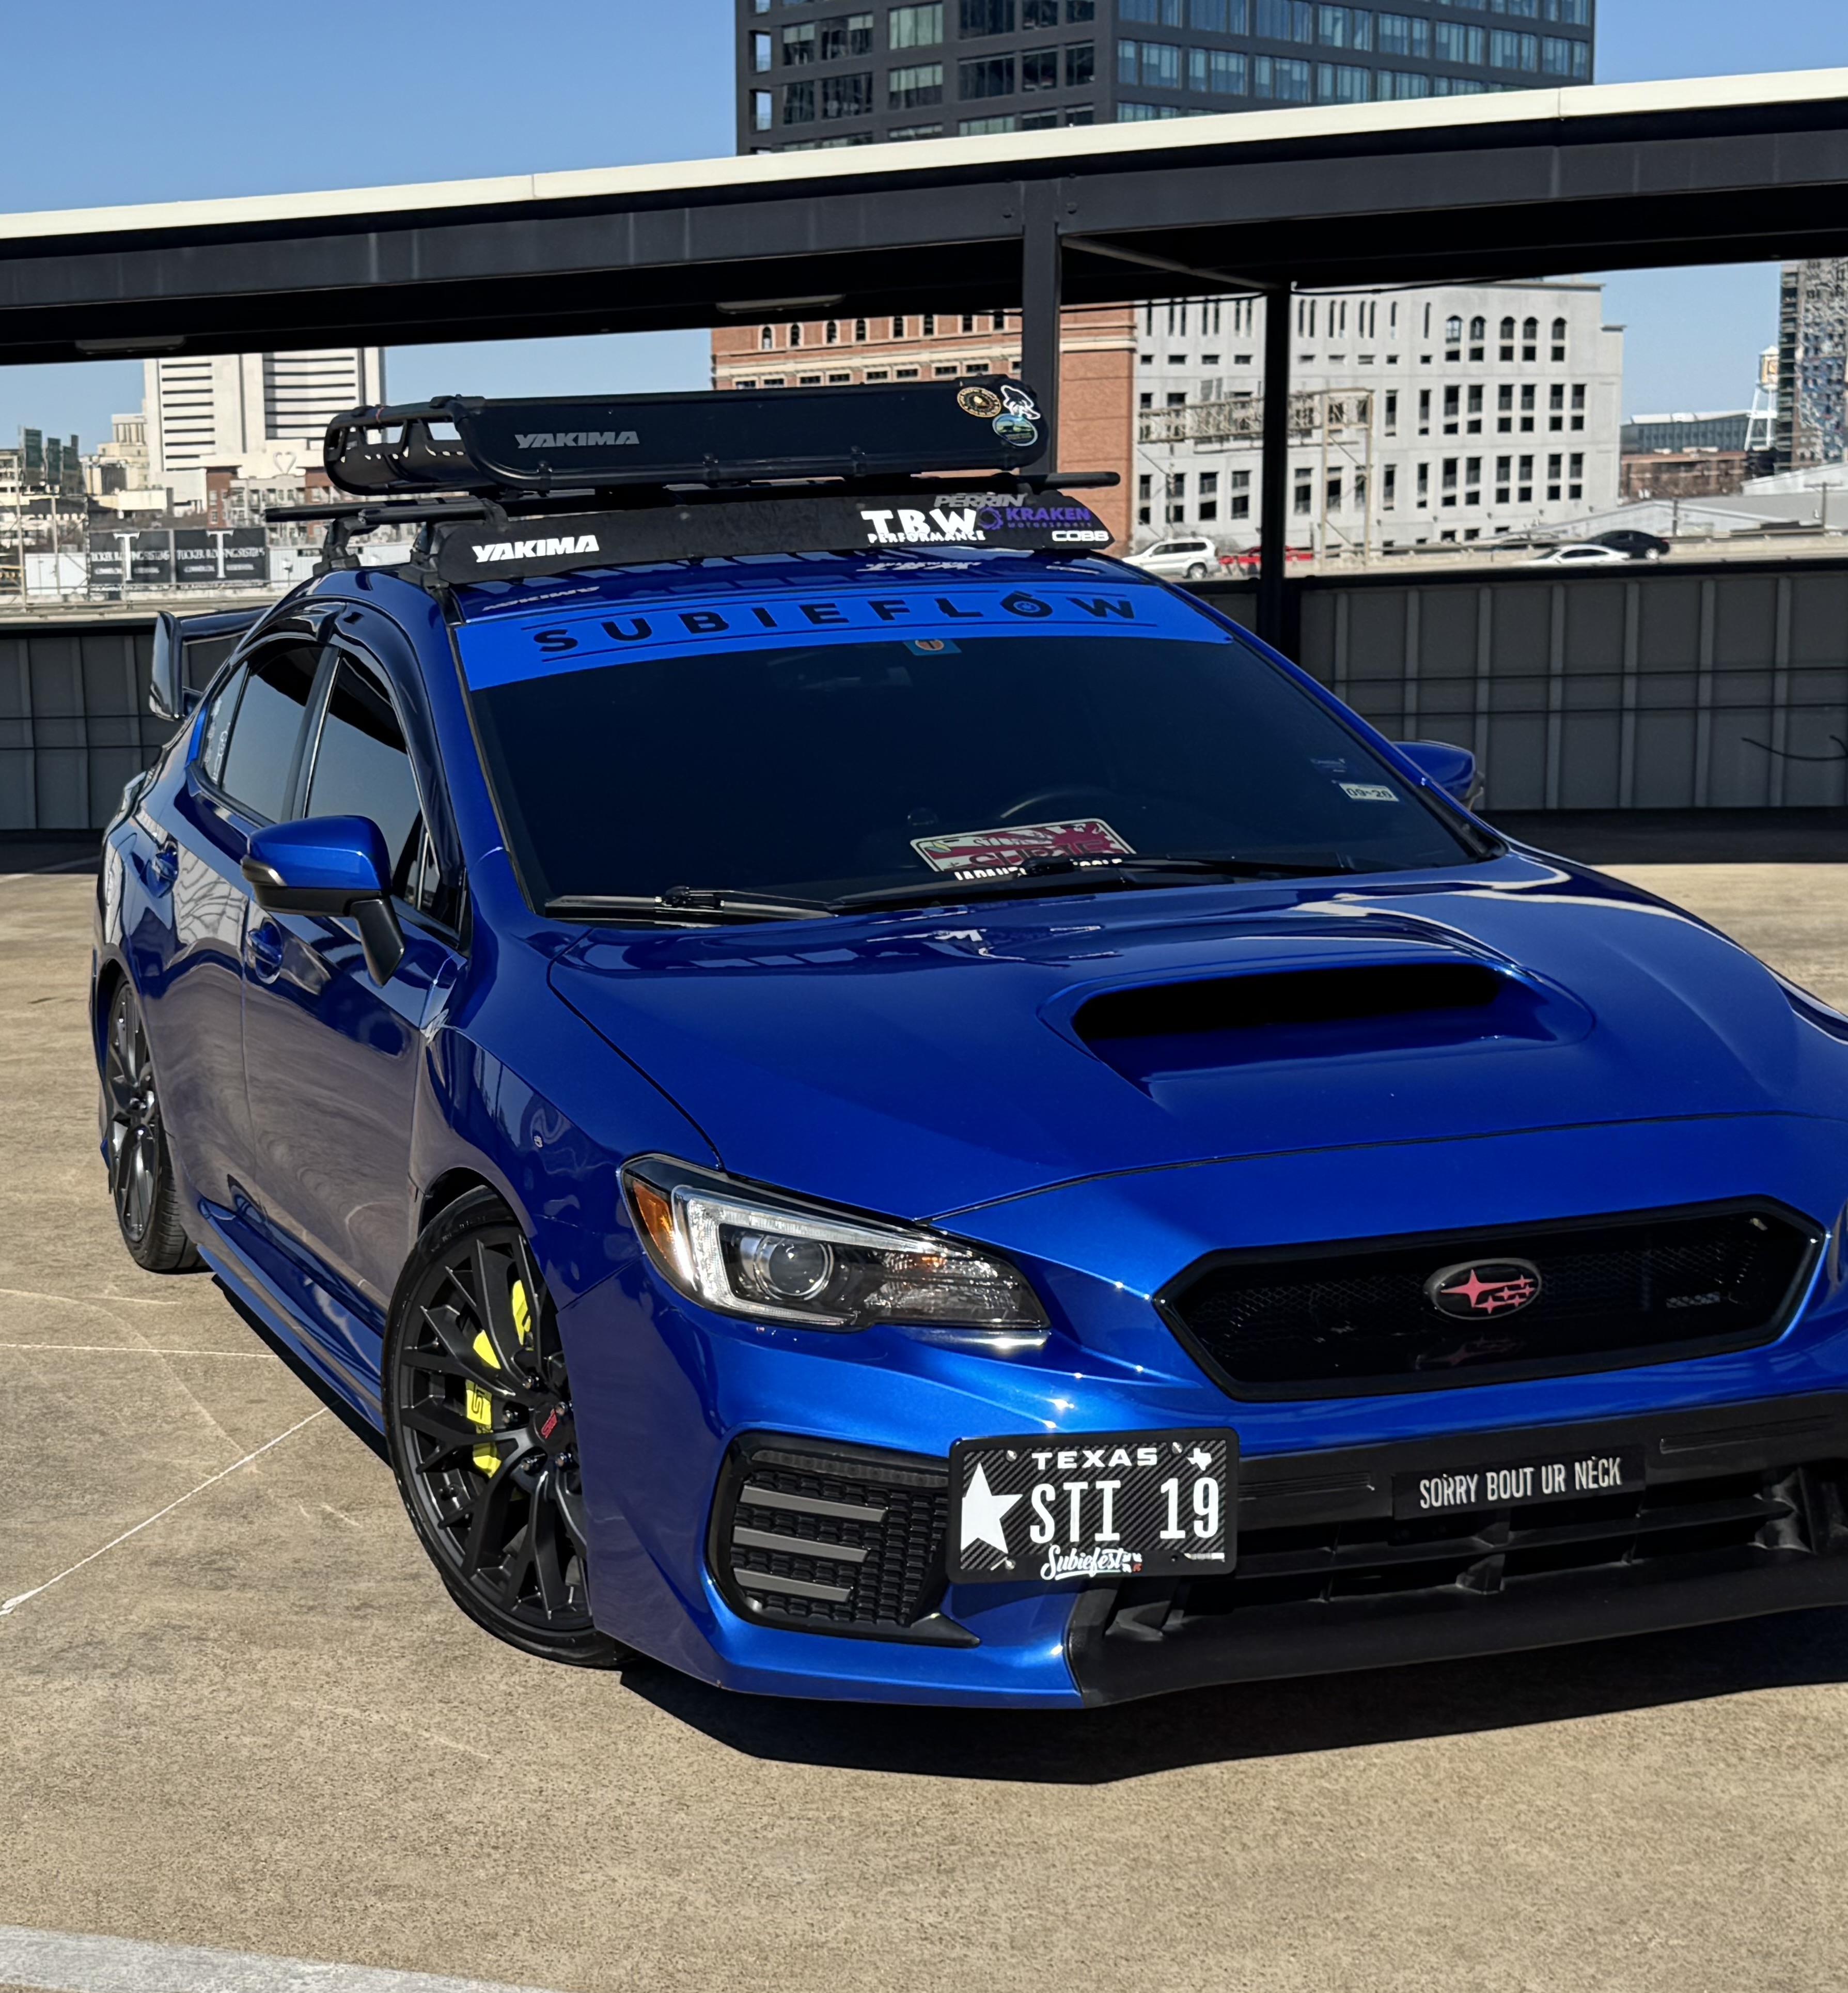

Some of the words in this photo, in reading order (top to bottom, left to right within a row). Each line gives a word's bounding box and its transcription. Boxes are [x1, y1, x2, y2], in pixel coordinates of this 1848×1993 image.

[515, 431, 640, 448] YAKIMA
[934, 493, 1028, 507] PERRIN
[860, 508, 977, 534] TBW
[1006, 507, 1091, 521] KRAKEN
[867, 530, 985, 543] PERFORMANCE
[1052, 530, 1109, 541] COBB
[472, 535, 600, 563] YAKIMA
[534, 590, 1135, 652] SUBIEFLOW
[1032, 1448, 1157, 1470] TEXAS
[1420, 1474, 1478, 1508] SORRY
[1486, 1468, 1534, 1500] BOUT
[1542, 1464, 1565, 1494] UR
[1575, 1457, 1621, 1490] NECK
[1030, 1480, 1121, 1543] STI
[1160, 1477, 1218, 1539] 19
